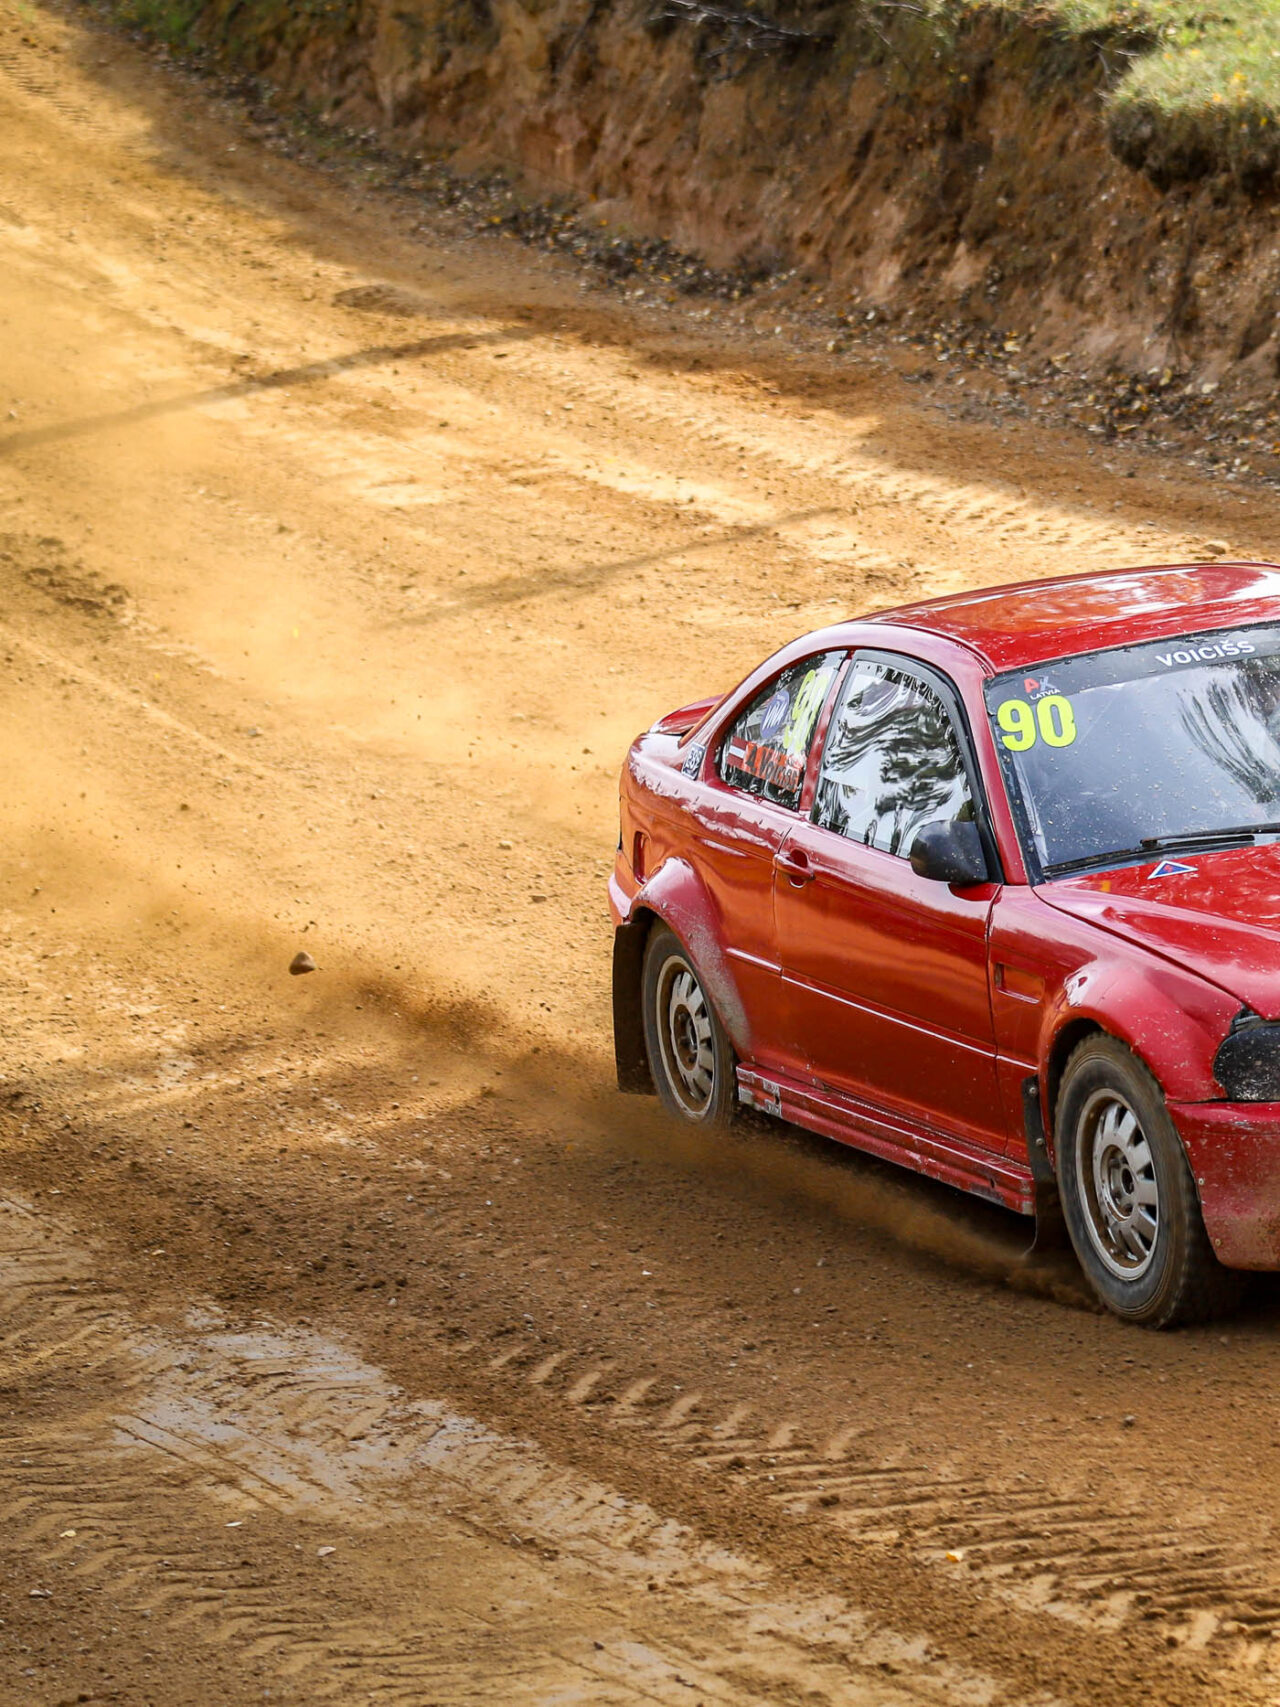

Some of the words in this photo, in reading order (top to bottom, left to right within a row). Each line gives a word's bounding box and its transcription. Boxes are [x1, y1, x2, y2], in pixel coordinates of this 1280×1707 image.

[1155, 640, 1256, 667] VOICIŠS
[1029, 688, 1061, 700] LATVIA
[997, 694, 1077, 752] 90
